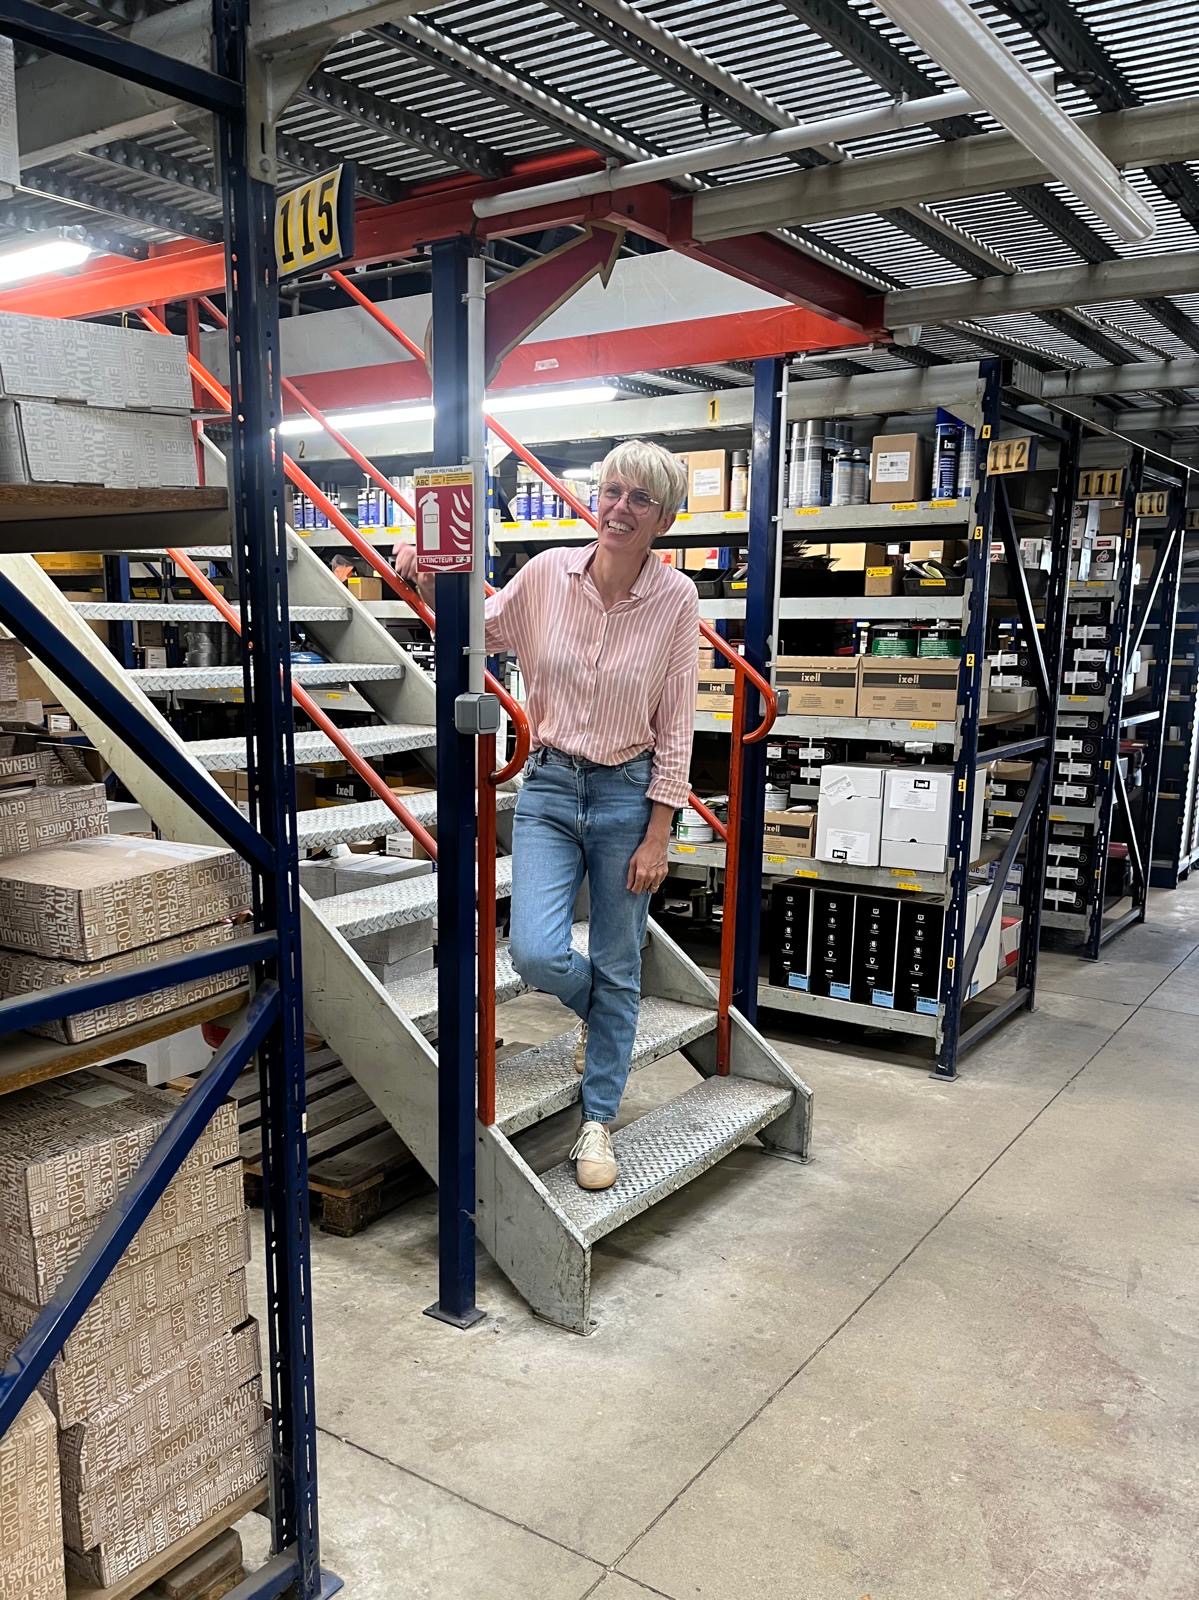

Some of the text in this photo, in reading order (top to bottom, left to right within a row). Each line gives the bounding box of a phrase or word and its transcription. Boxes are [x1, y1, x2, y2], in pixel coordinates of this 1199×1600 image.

[281, 178, 335, 264] 115
[709, 400, 716, 421] 1
[983, 427, 989, 437] 4
[298, 440, 305, 459] 2
[990, 441, 1026, 472] 112
[416, 479, 429, 487] ABC
[1081, 473, 1119, 496] 111
[1137, 493, 1165, 515] 110
[976, 527, 982, 538] 3
[418, 556, 453, 564] EXTINCTEUR
[968, 655, 973, 665] 2
[801, 672, 821, 682] ixell
[898, 674, 919, 684] ixell
[709, 684, 726, 692] ixell
[336, 783, 354, 797] ixell
[36, 820, 72, 839] ORIGEN
[764, 824, 780, 832] ixell
[197, 897, 231, 918] PIECES
[145, 1263, 157, 1309] ORIGEN
[139, 1330, 152, 1375] ORIGEN
[158, 1386, 171, 1430] ORIGEN
[163, 1422, 249, 1491] PIECES D'ORIGINE
[28, 1411, 50, 1532] PIECES D'ORIGINE
[131, 1467, 144, 1509] PIEZAS
[151, 1502, 166, 1553] ORIGINE
[8, 1550, 49, 1584] PIEZAS
